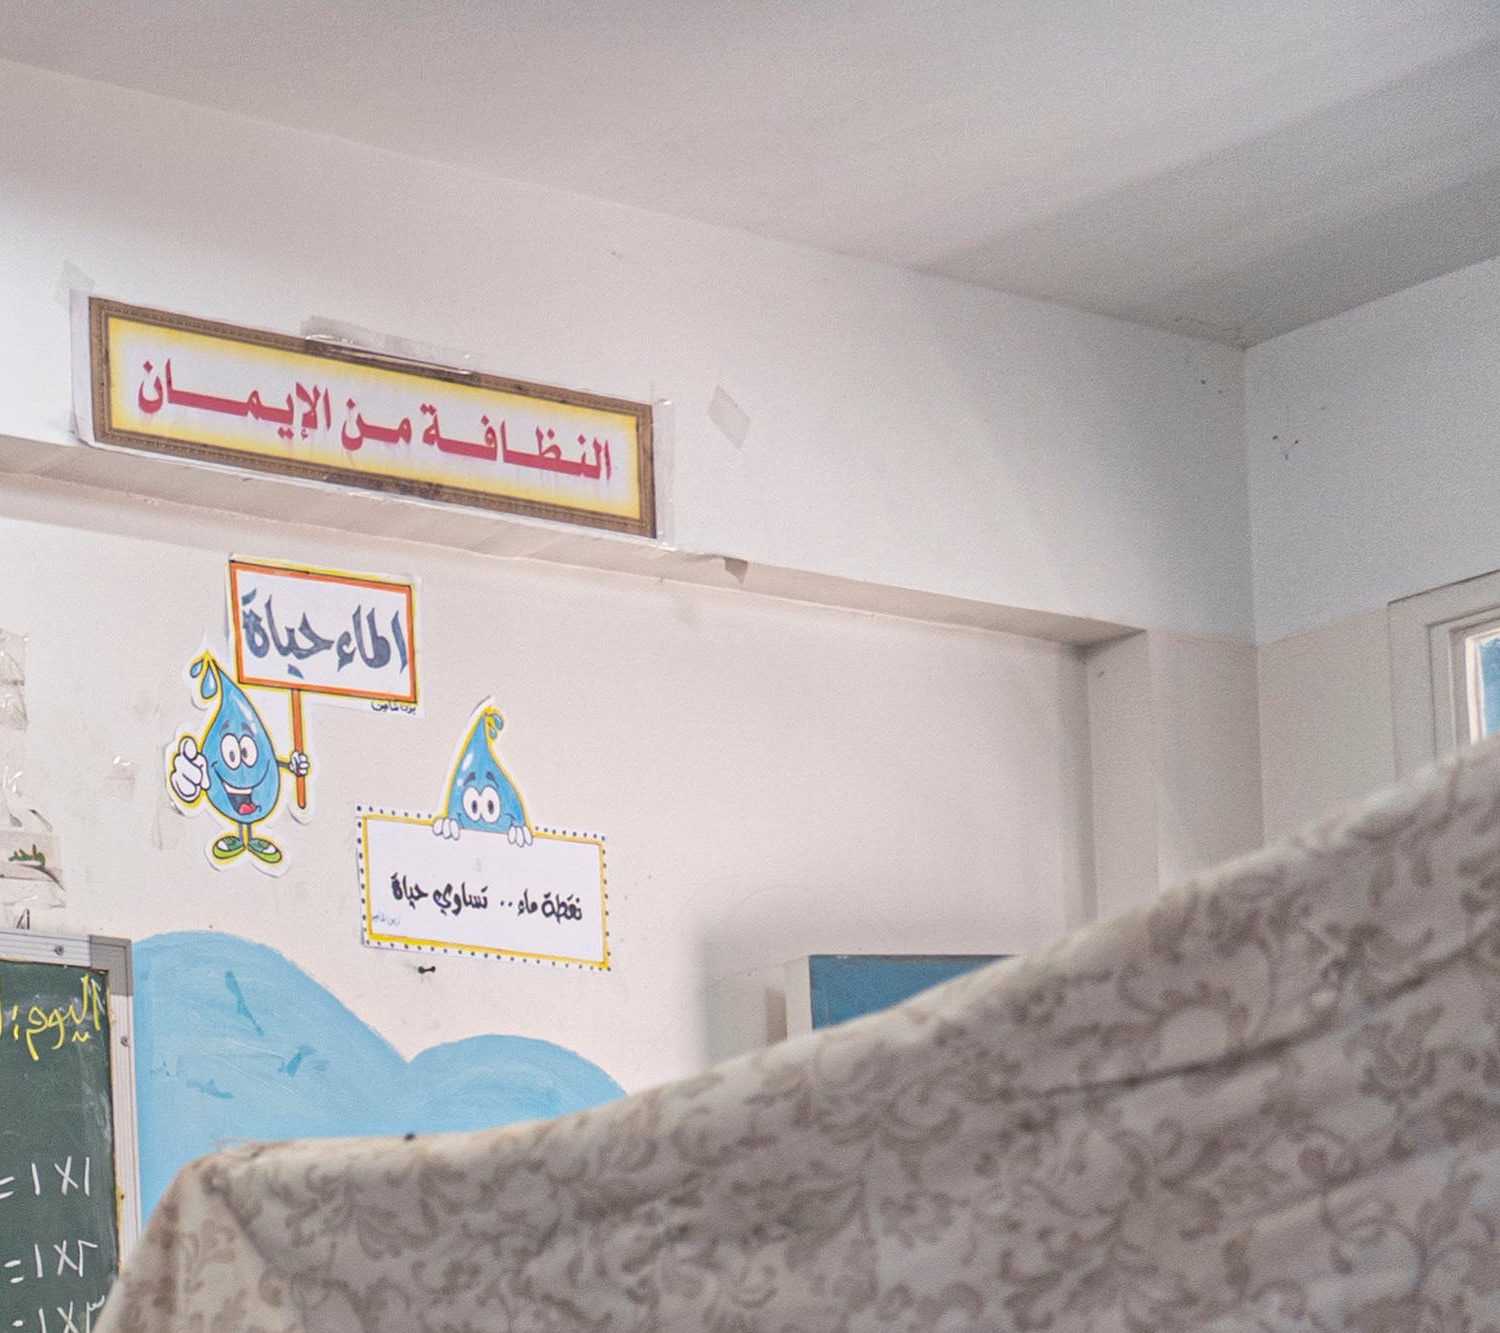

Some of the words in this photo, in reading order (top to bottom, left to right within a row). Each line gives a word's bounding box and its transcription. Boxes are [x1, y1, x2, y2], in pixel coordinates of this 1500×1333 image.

[137, 358, 332, 442] الإيمان
[341, 398, 412, 450] من
[420, 404, 612, 481] النظافة
[336, 604, 408, 675] الماء
